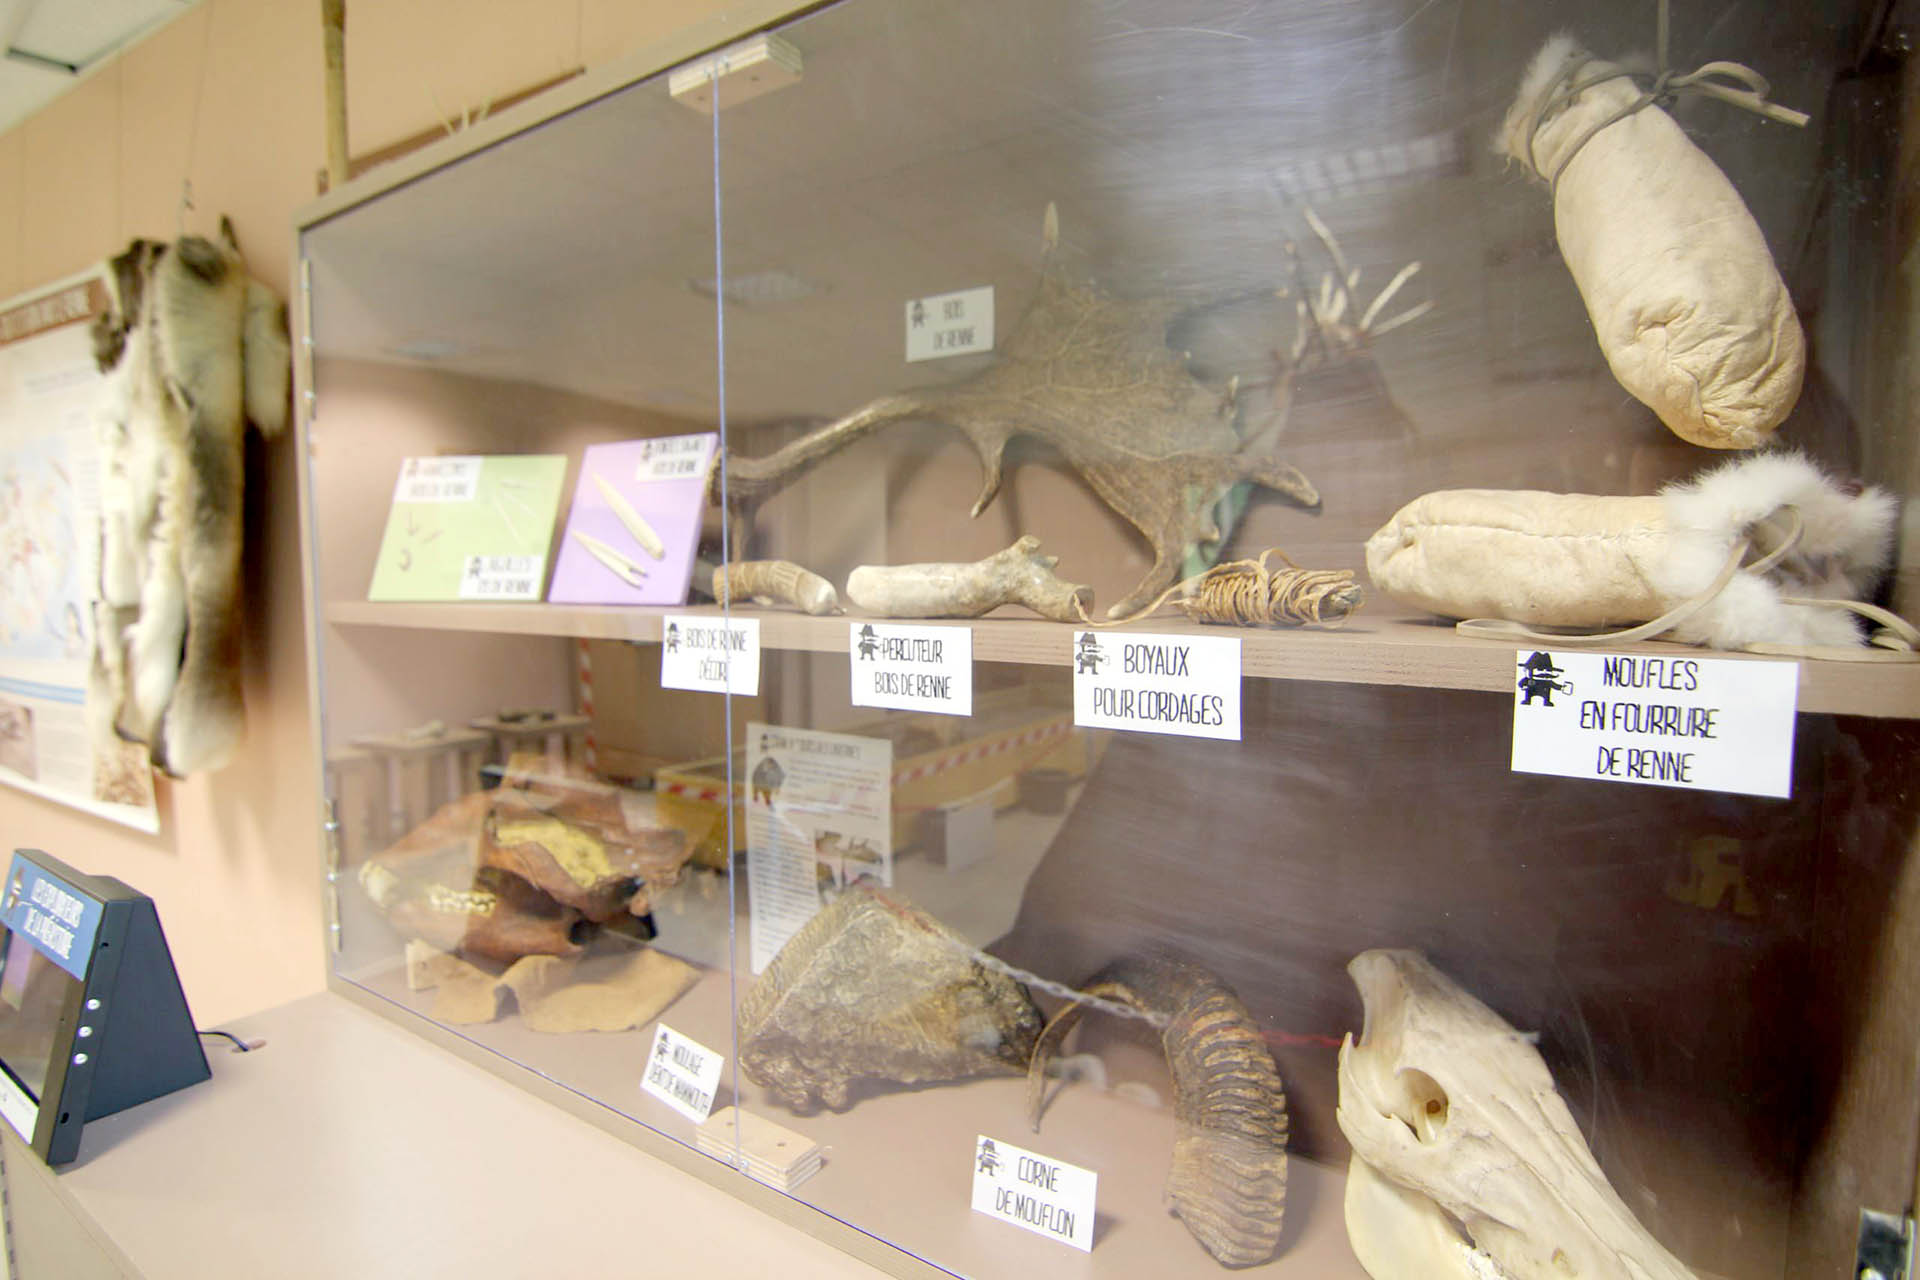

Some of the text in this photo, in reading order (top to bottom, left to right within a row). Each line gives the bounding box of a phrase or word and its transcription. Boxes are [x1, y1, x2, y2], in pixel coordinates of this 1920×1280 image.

[687, 628, 705, 648] BOIS
[708, 629, 717, 650] DE
[883, 637, 942, 663] PERCUTEUR
[1124, 644, 1190, 677] BOYAUX
[1603, 657, 1698, 691] MOUFLES
[875, 671, 952, 700] BOIS DE RENNE
[1094, 687, 1223, 726] POUR CORDAGES
[1580, 700, 1720, 739] EN FOURRURE
[1597, 746, 1696, 783] DE RENNE
[1018, 1156, 1061, 1192] CORNE
[996, 1187, 1075, 1239] DE MOUFLON
